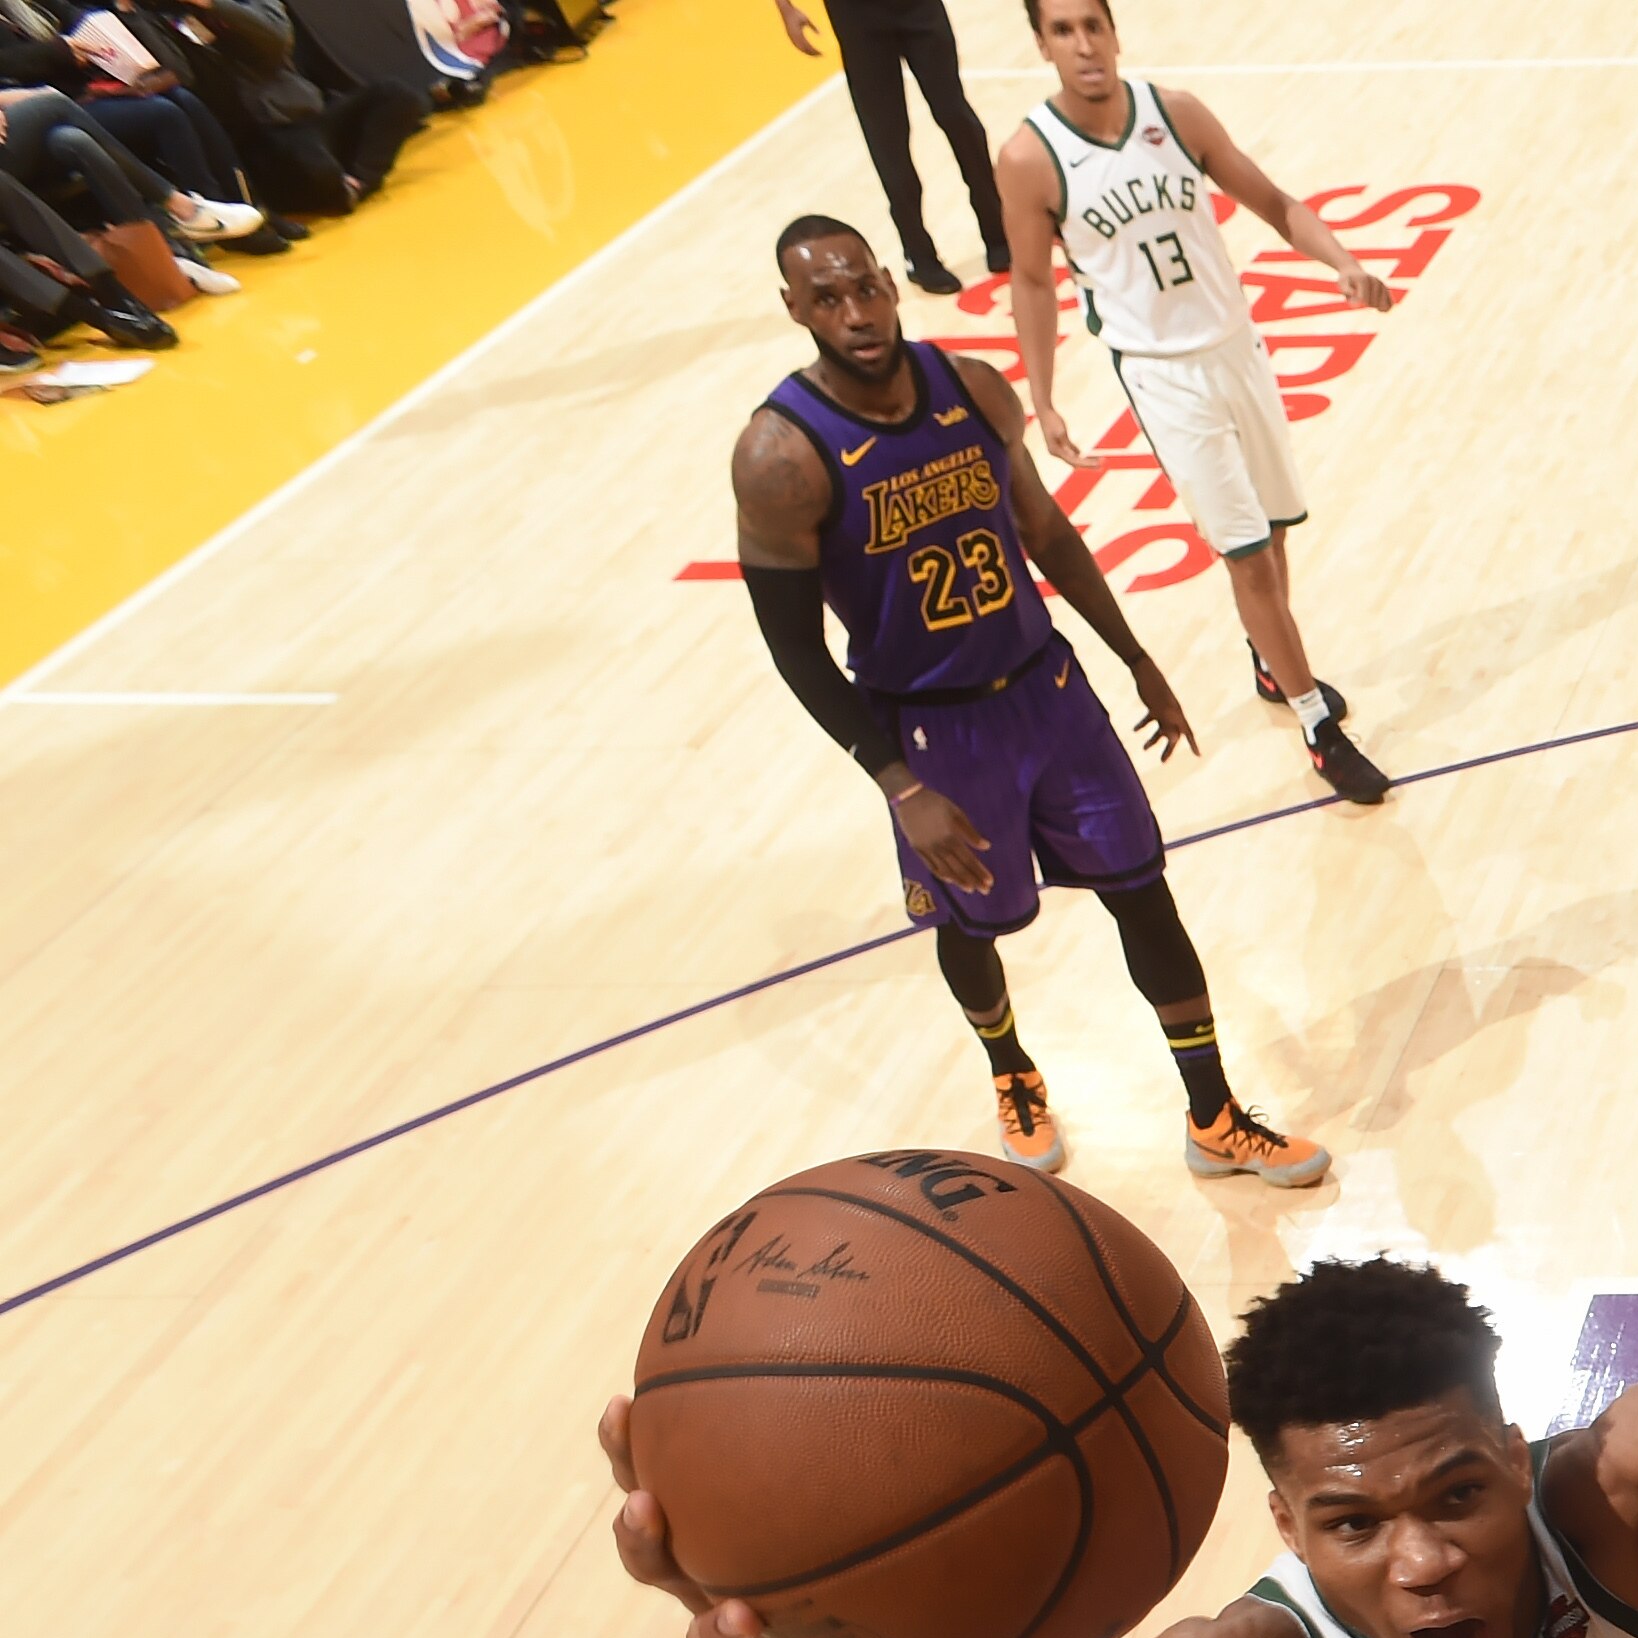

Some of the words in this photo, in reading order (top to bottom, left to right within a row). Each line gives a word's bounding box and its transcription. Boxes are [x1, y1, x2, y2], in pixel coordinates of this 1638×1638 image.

[1082, 174, 1196, 239] BUCKS
[1138, 231, 1195, 292] 13
[862, 459, 999, 555] LAKERS
[907, 527, 1015, 632] 23
